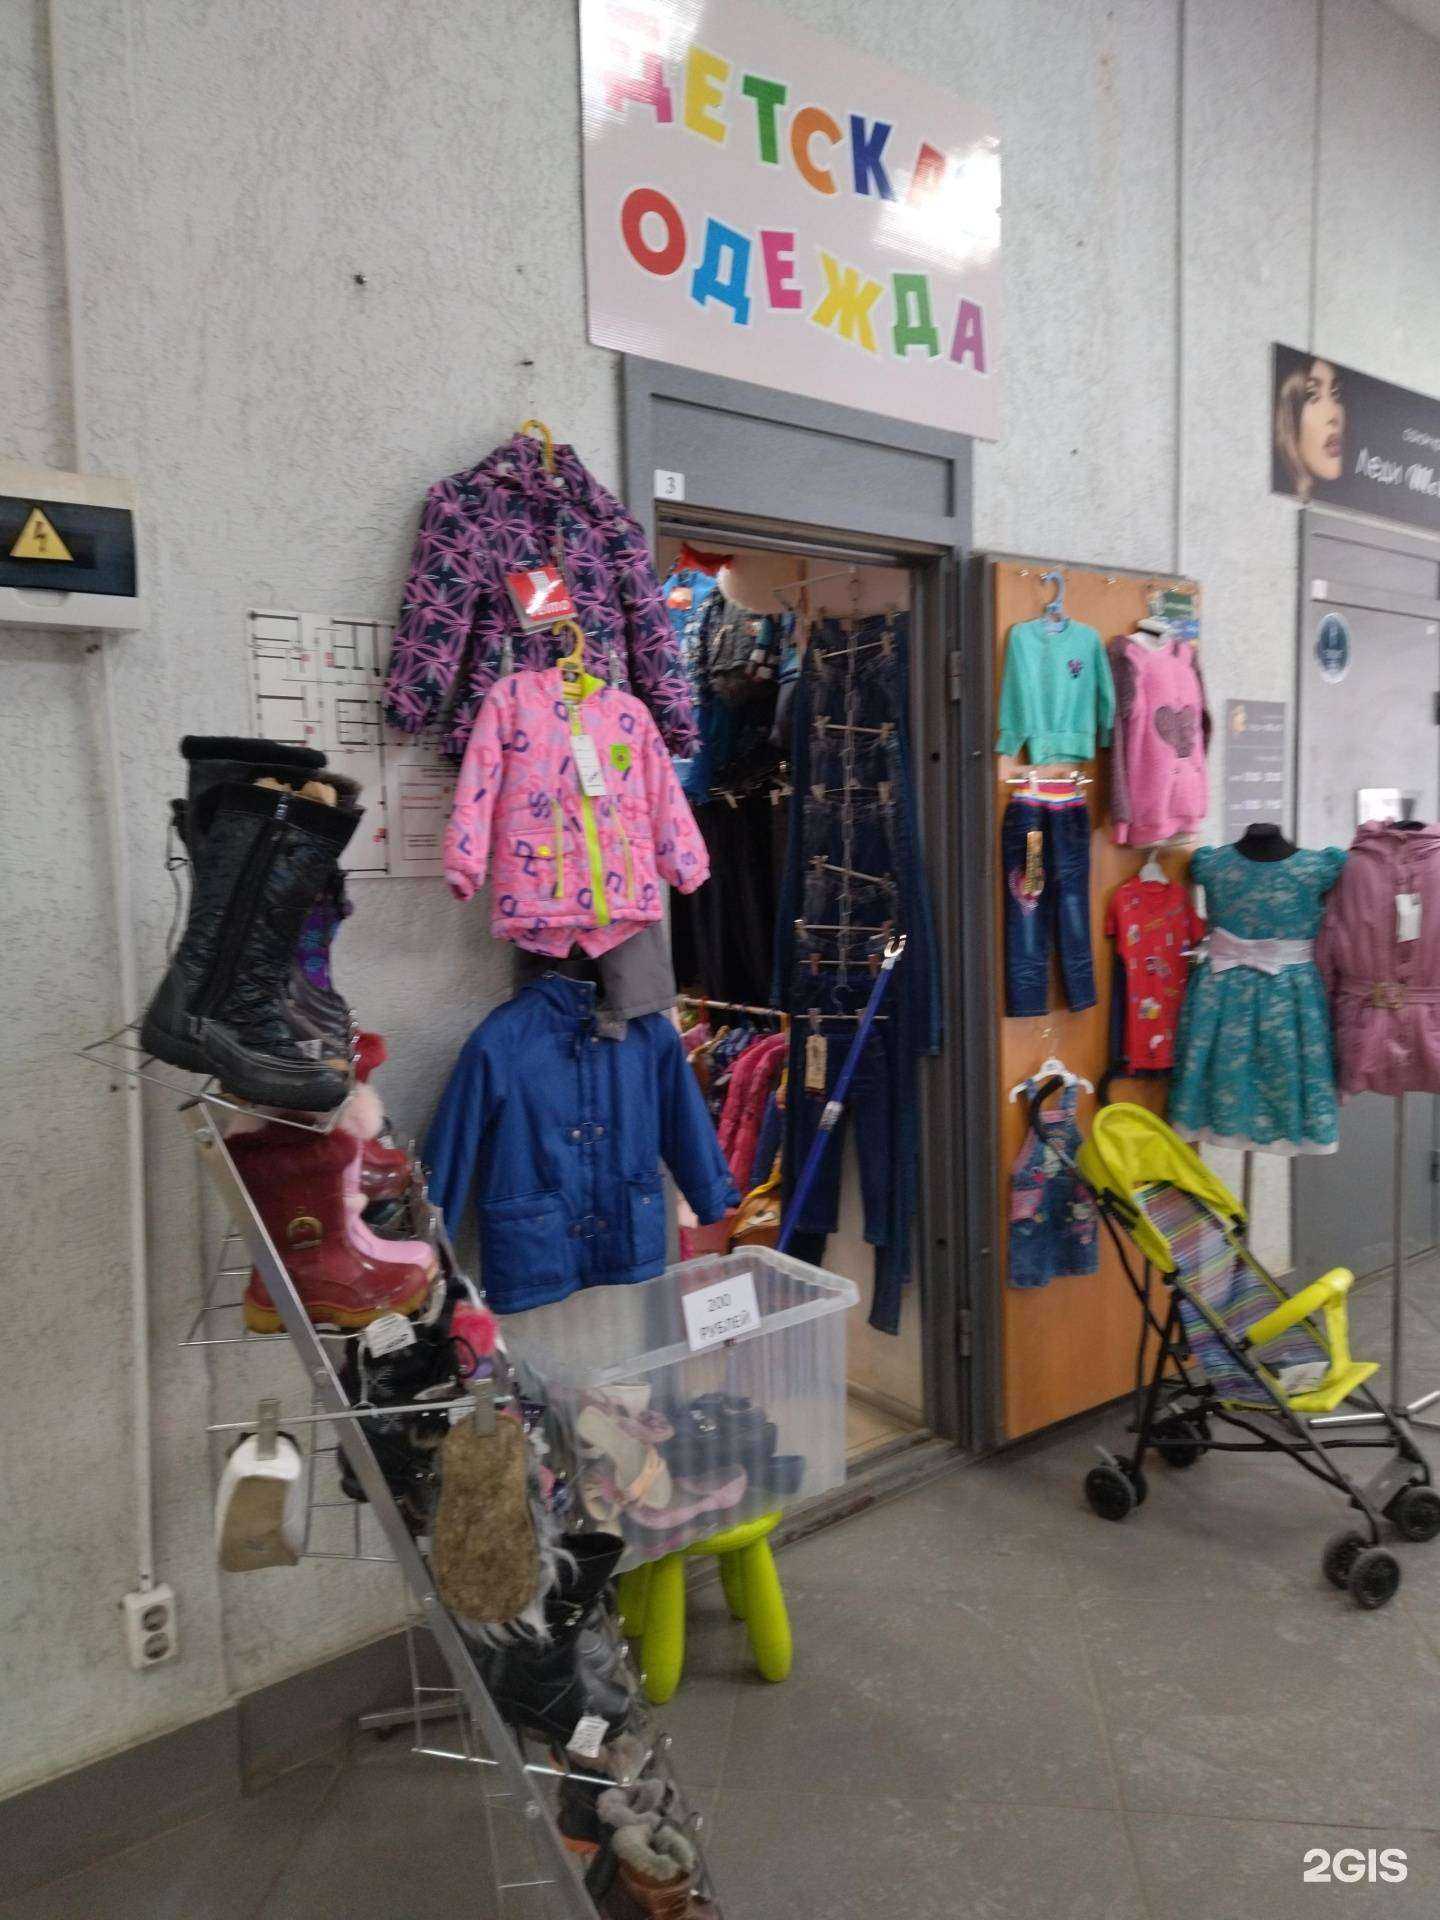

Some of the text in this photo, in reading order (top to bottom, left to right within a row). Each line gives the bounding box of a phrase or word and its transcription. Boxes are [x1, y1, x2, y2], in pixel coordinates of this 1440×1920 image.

[601, 18, 985, 215] ДЕТСКА
[621, 187, 986, 374] ОДЕЖДА
[664, 476, 677, 494] 3
